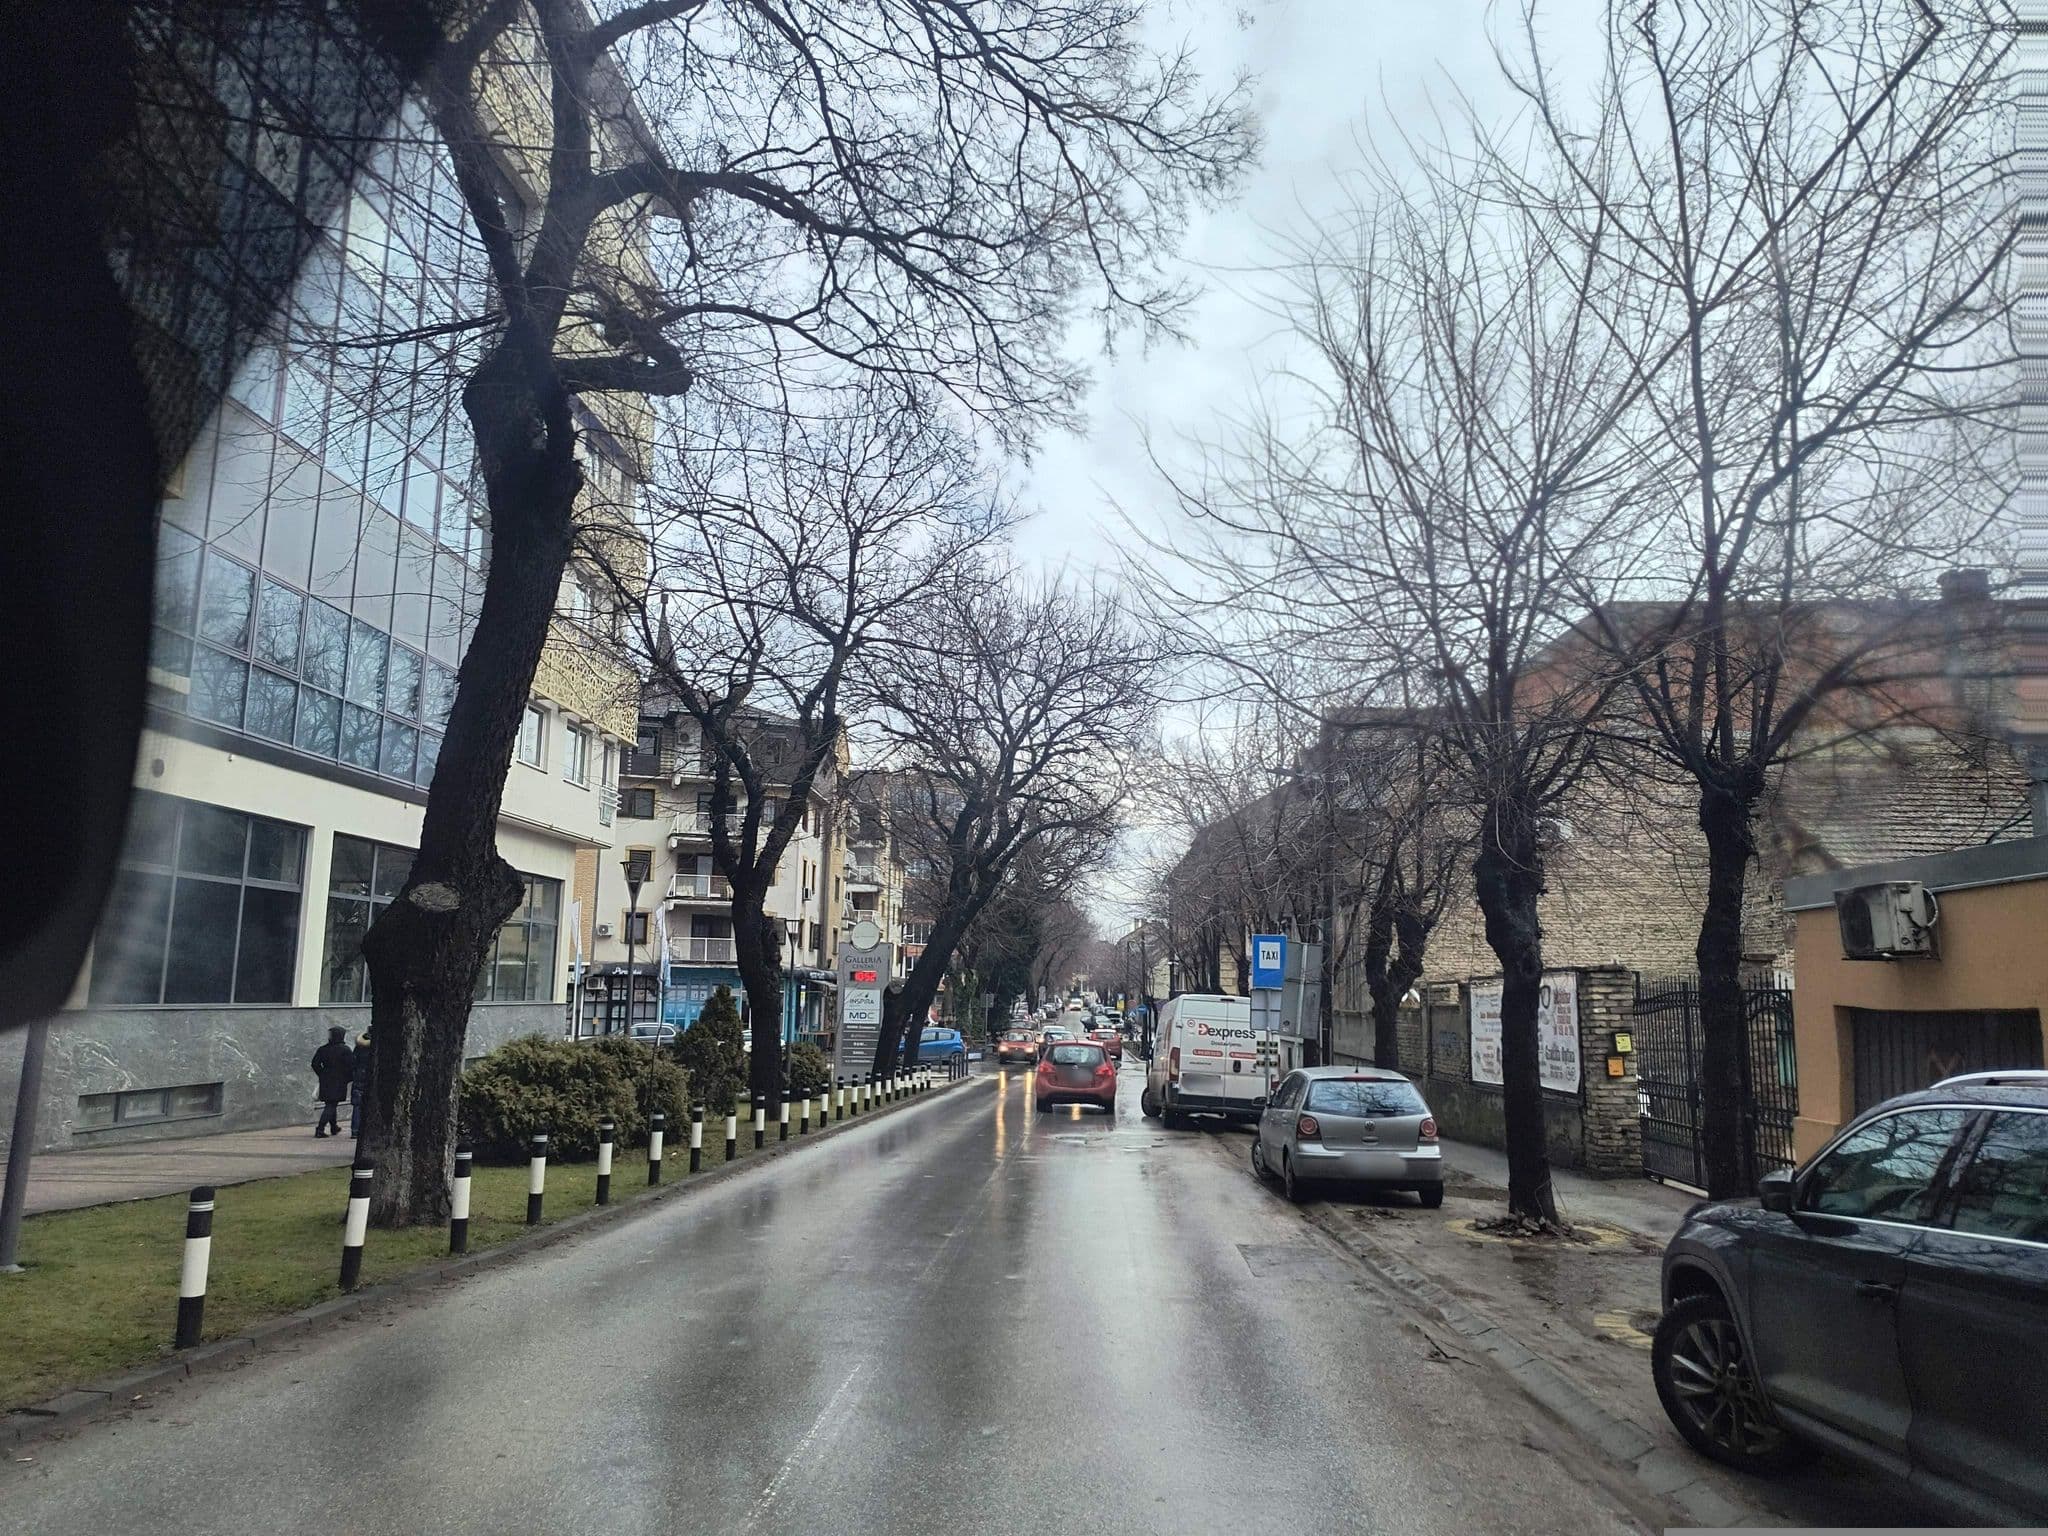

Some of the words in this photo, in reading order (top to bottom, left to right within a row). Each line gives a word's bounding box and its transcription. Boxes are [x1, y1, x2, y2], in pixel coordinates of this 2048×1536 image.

[1261, 950, 1279, 960] TAXI
[849, 1012, 875, 1020] MDC
[1198, 1023, 1256, 1040] Dexpress
